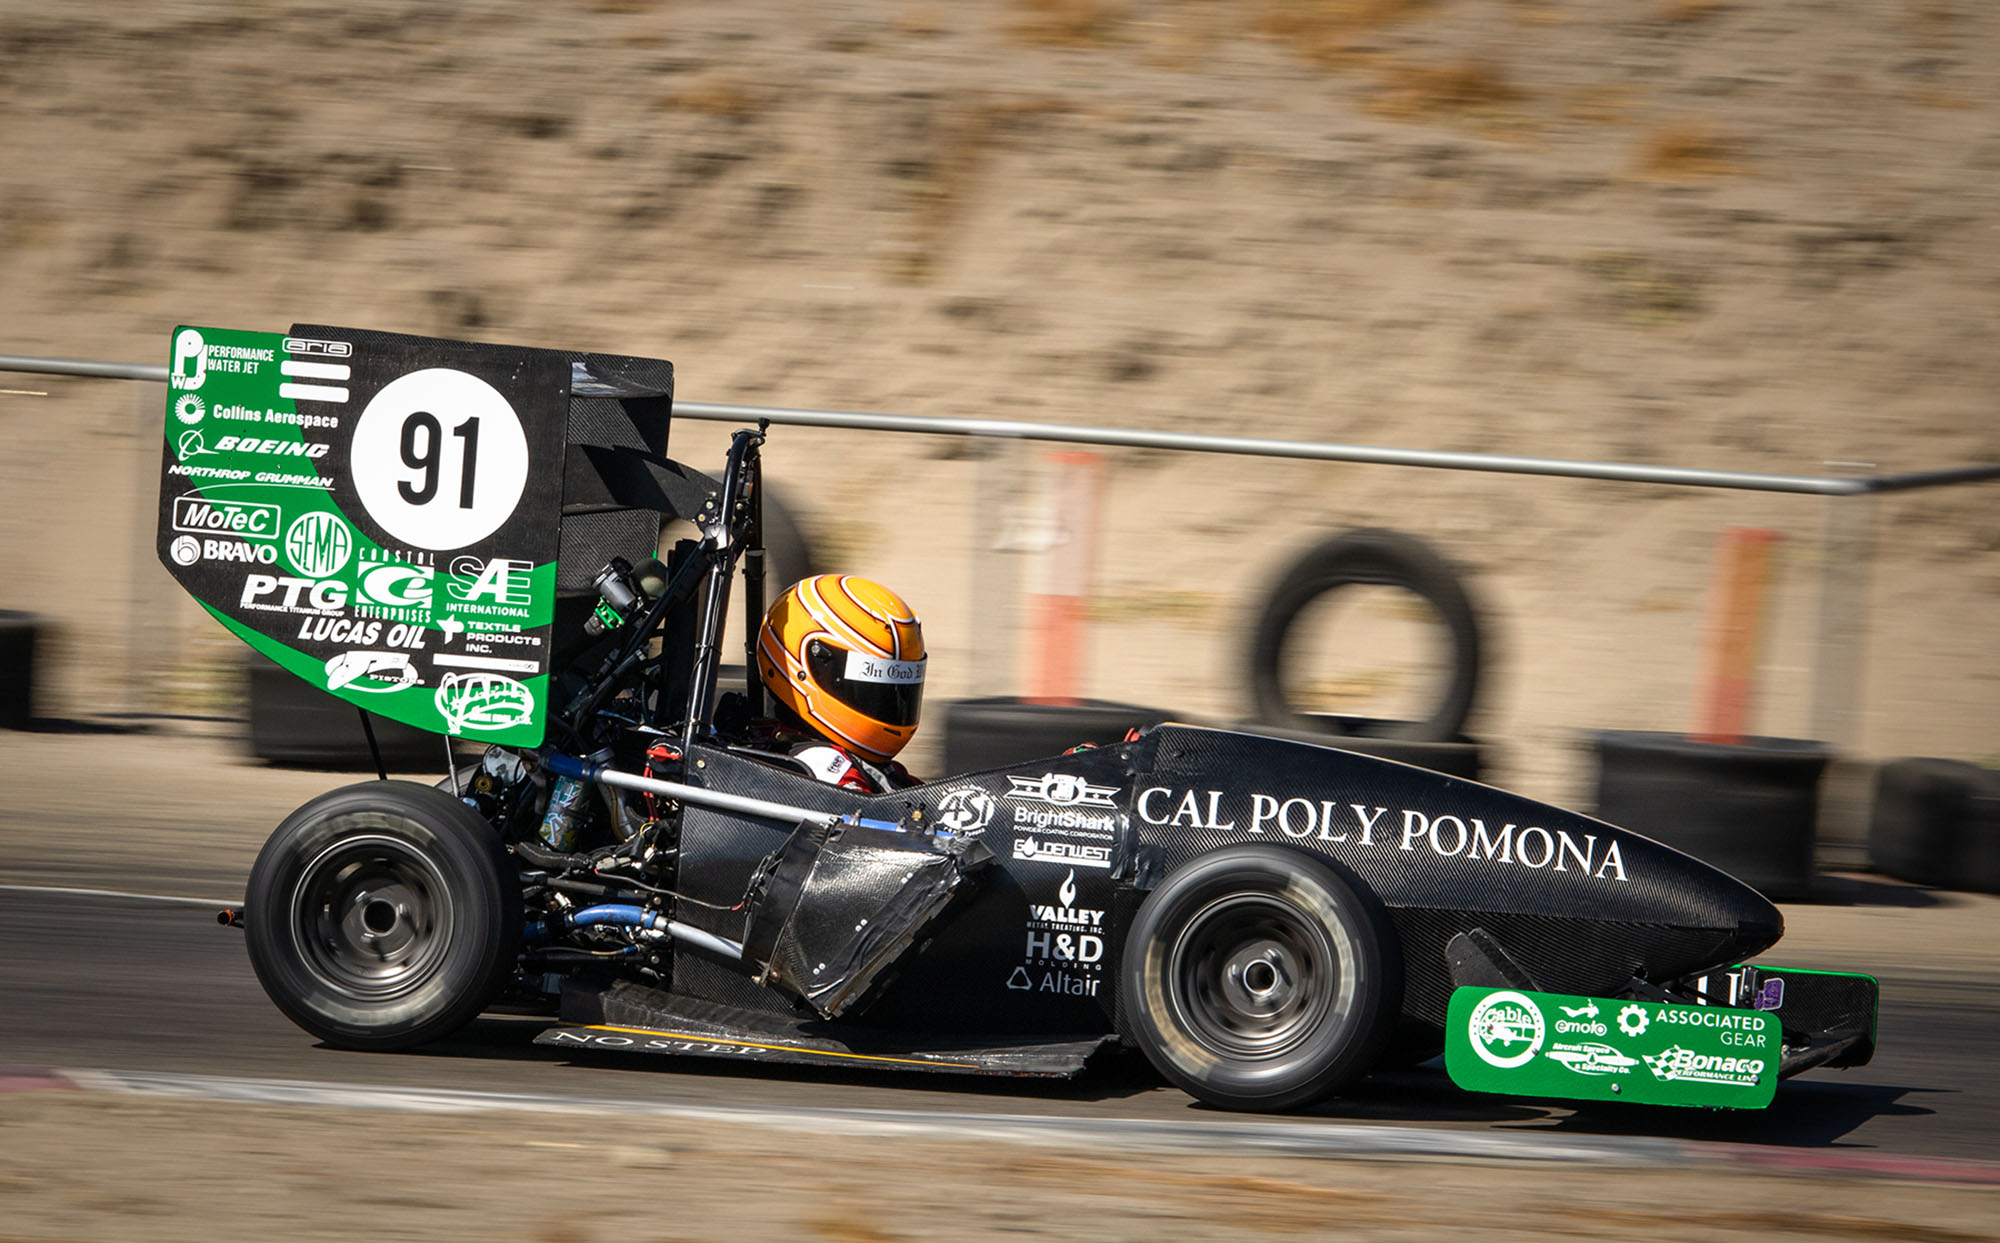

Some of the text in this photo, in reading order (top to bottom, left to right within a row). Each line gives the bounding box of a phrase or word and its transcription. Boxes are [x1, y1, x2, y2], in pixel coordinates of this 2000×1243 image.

[208, 345, 275, 362] PERFORMANCE
[286, 341, 347, 354] aria
[207, 358, 259, 374] WATER JET
[213, 404, 339, 429] Collins Aerospace
[214, 436, 330, 458] BOEING
[397, 411, 480, 509] 91
[168, 464, 334, 487] NORTHROP GRUMMAN
[182, 503, 270, 532] MoTeC
[203, 539, 278, 565] BRAVO
[290, 515, 348, 573] SEMA
[359, 547, 435, 566] COASTAL
[240, 573, 349, 610] PTG
[446, 555, 534, 606] SAE
[354, 605, 431, 623] ENTERPRISES
[446, 602, 530, 618] INTERNATIONAL
[297, 616, 426, 649] LUCAS OIL
[467, 620, 521, 633] TEXTILE
[465, 643, 493, 654] INC.
[466, 632, 541, 646] PRODUCTS
[862, 661, 883, 678] In
[887, 663, 913, 680] God
[1014, 807, 1115, 831] BrightShark
[1013, 825, 1114, 840] POWDER COATING CORPORATION
[1137, 787, 1629, 882] CAL POLY POMONA
[1029, 904, 1105, 925] VALLEY
[1026, 931, 1104, 962] H&D
[1025, 959, 1102, 971] MOLDING
[1040, 970, 1100, 996] Altair
[1656, 1009, 1765, 1031] ASSOCIATED
[552, 1032, 767, 1054] NO STEP
[1720, 1031, 1766, 1047] GEAR
[1674, 1049, 1765, 1074] Bonaco
